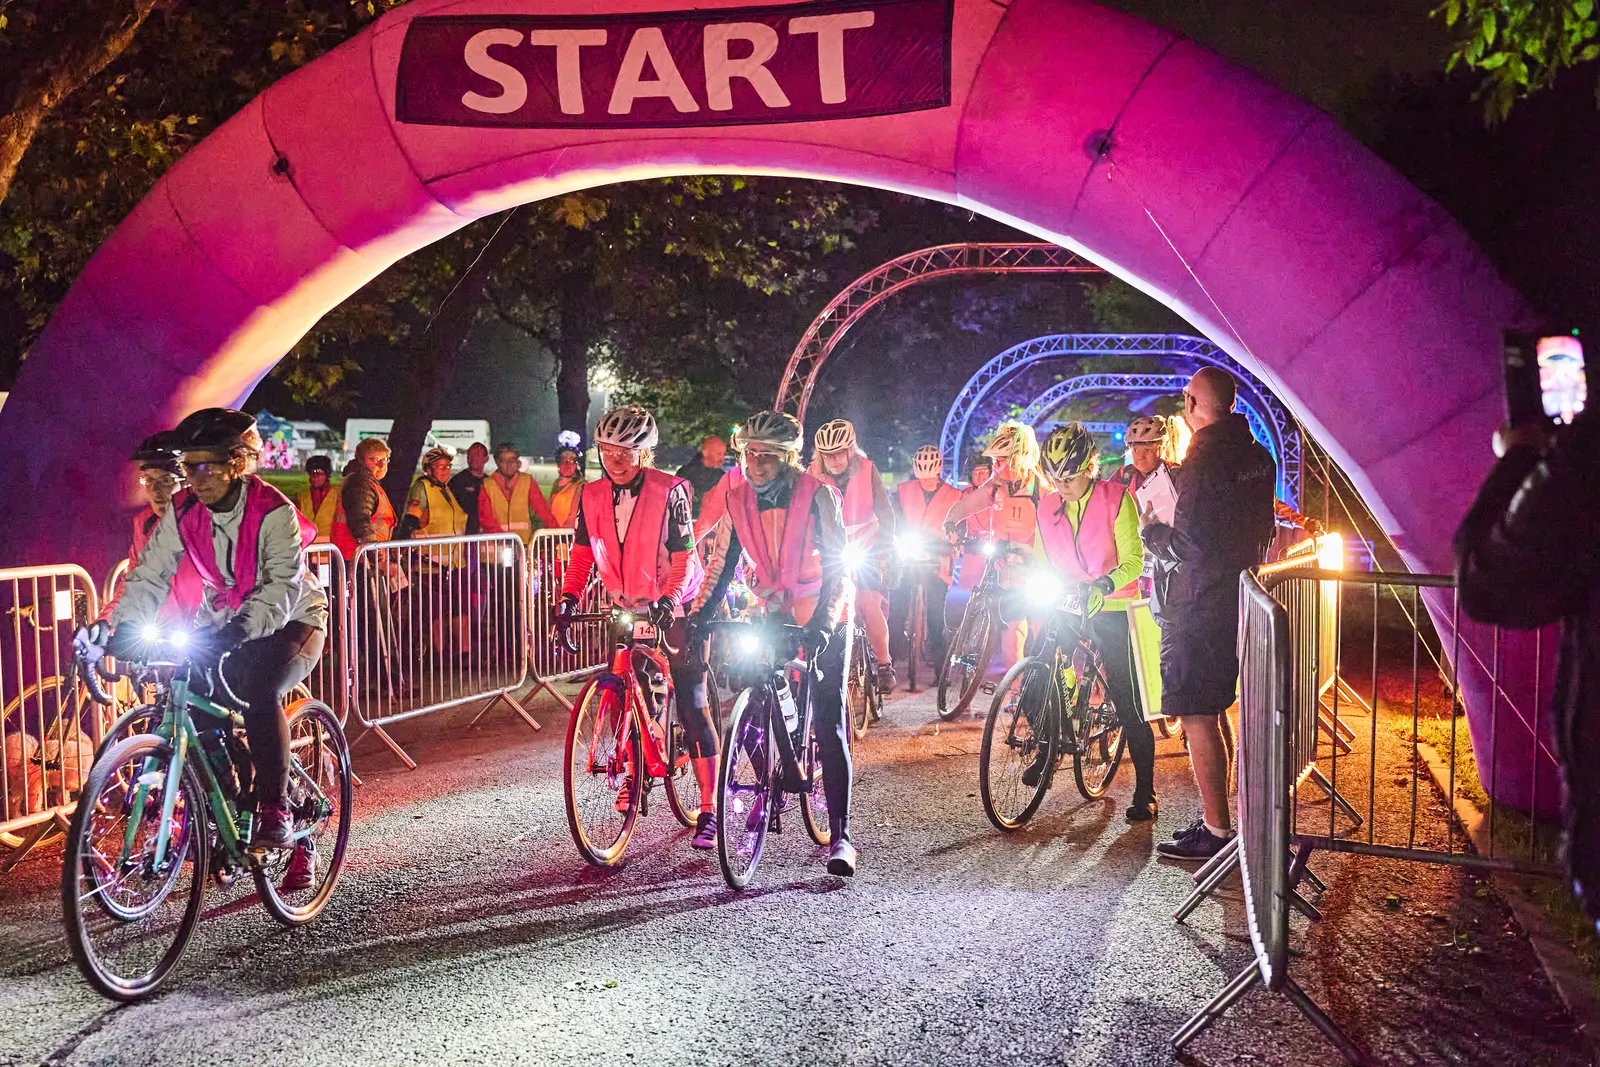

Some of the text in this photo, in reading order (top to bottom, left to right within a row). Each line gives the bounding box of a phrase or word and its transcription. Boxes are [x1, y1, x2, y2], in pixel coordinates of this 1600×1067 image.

[461, 11, 875, 115] START
[1012, 506, 1022, 519] 11
[1063, 600, 1080, 610] 140
